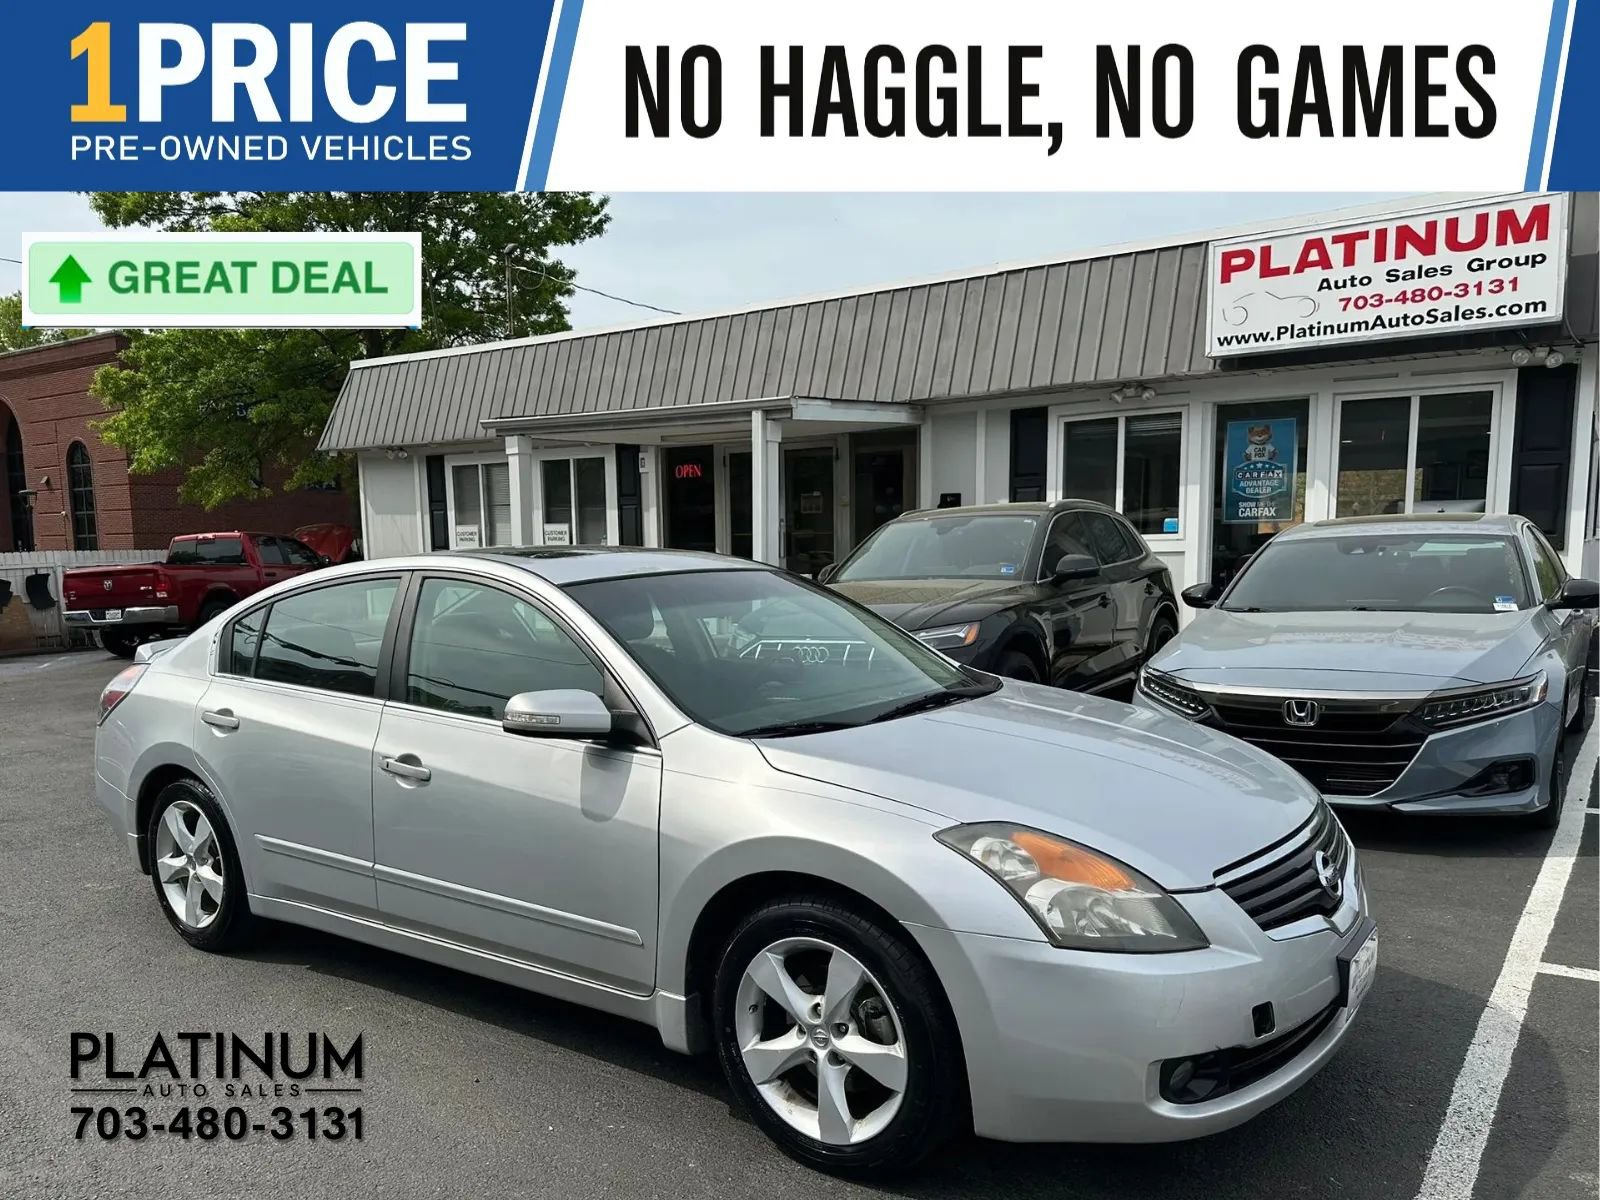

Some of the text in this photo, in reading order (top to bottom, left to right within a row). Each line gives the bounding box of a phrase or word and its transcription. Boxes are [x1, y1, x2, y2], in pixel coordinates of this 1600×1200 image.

[1220, 203, 1551, 284] PLATINUM
[1317, 252, 1547, 293] Auto Sales Group
[1338, 276, 1520, 313] 703-480-3131
[1216, 299, 1547, 347] www.PlatinumAutoSales.com
[675, 464, 702, 479] OPEN
[1237, 470, 1283, 479] CARFAX
[1238, 507, 1277, 517] CARFAX
